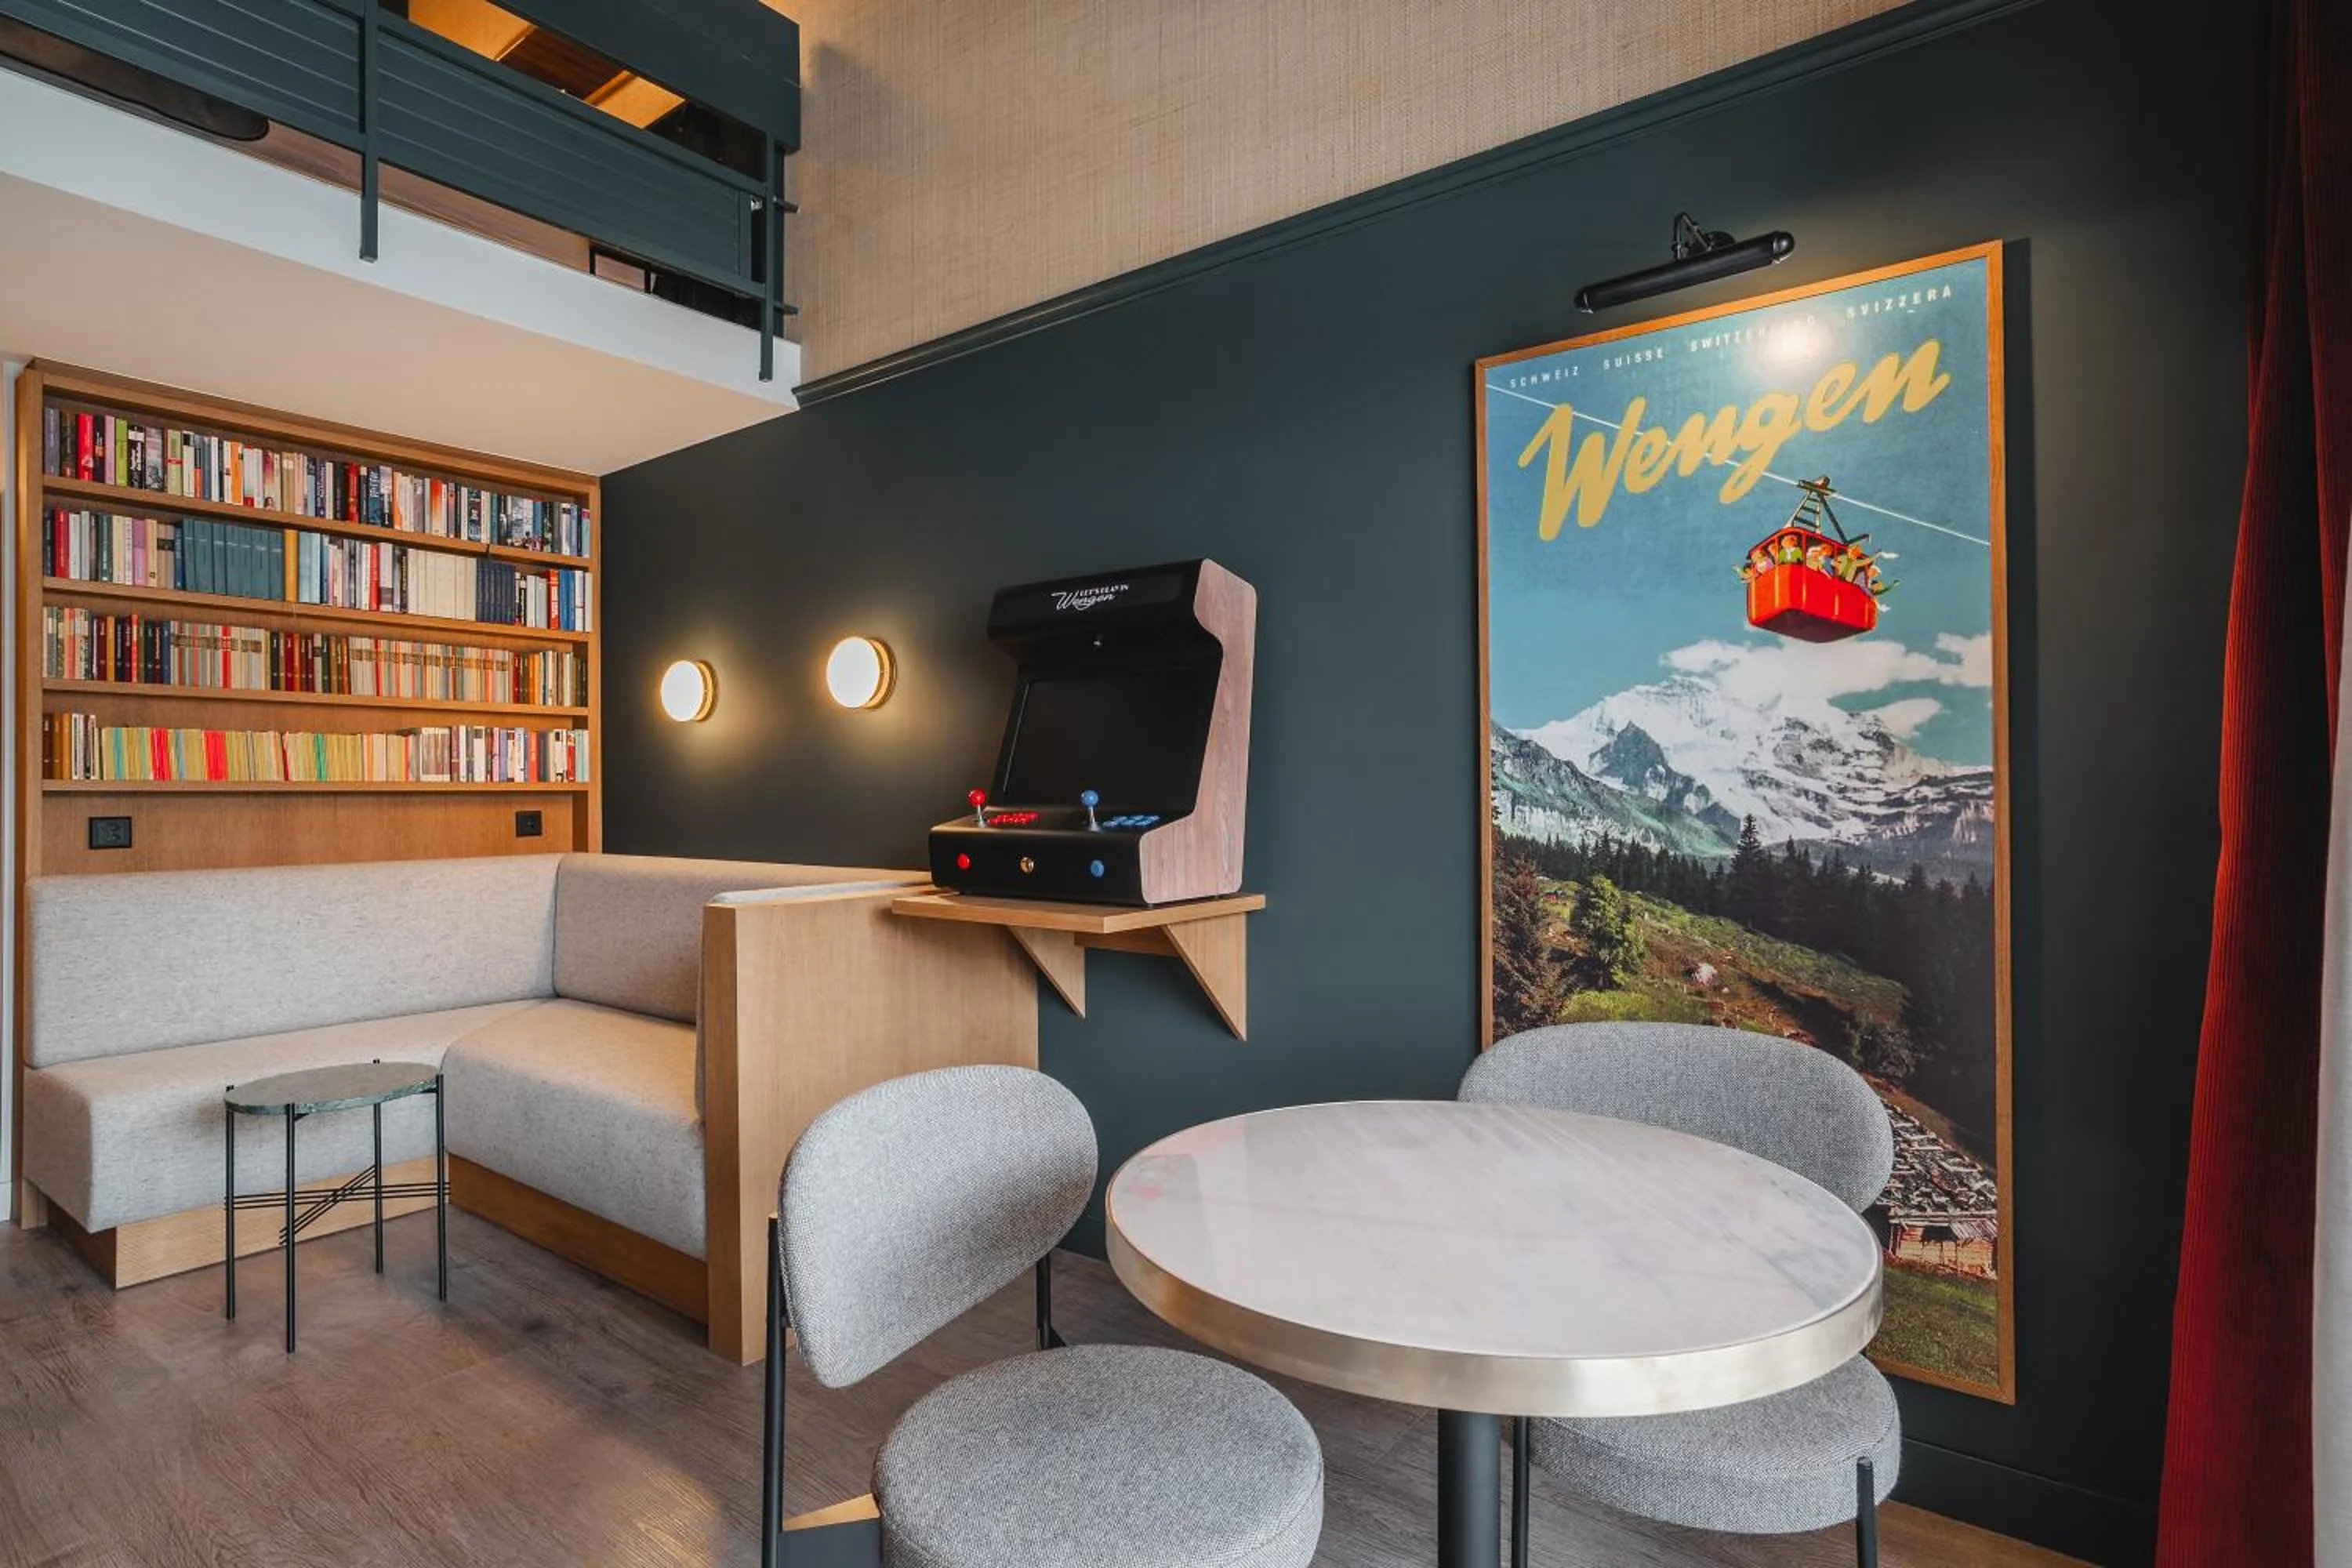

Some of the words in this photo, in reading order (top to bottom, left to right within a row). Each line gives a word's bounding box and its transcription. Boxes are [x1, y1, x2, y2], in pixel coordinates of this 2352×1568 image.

[1509, 365, 1580, 389] SCHWEIZ
[1603, 347, 1664, 370] SUISSE
[1690, 315, 1816, 352] SWITZERD
[1846, 284, 1952, 320] SVIZZERA
[1518, 339, 1951, 541] Wengen
